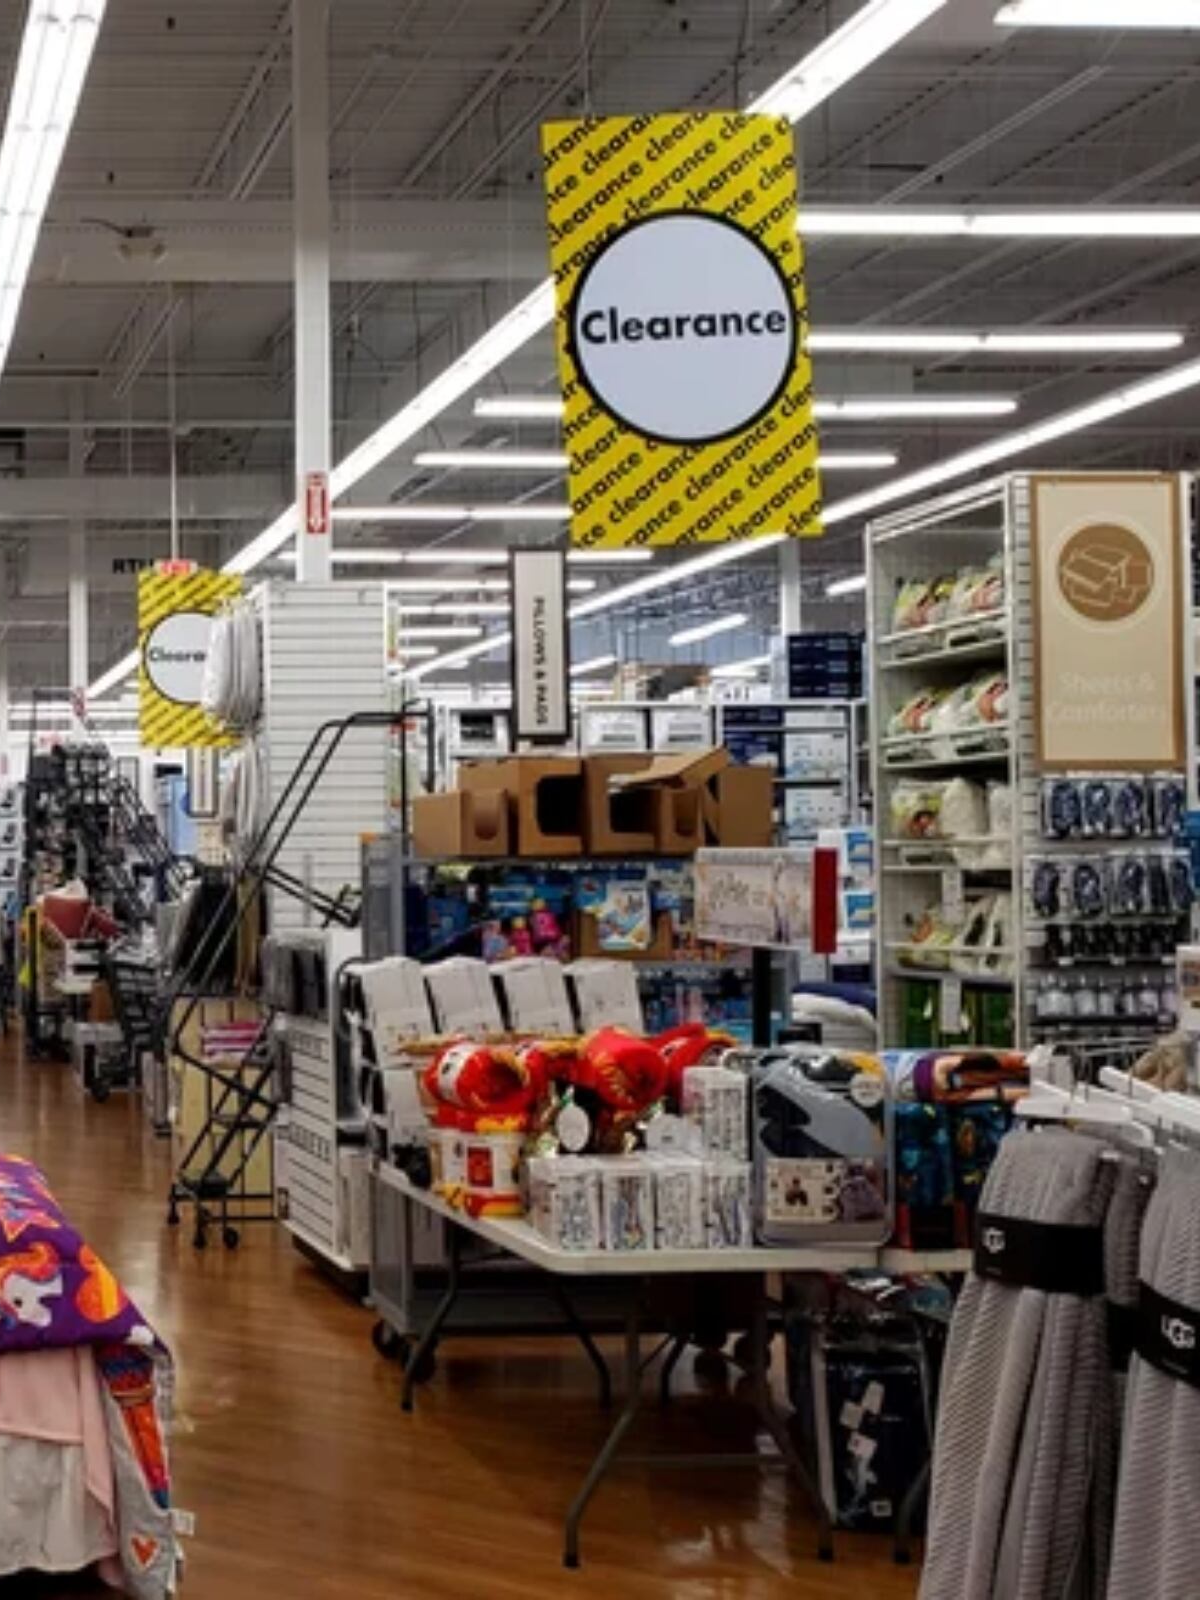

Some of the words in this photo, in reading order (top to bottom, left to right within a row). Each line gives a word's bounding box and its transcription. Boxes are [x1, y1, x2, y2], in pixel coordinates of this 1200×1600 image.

[624, 139, 717, 221] clearance
[580, 306, 787, 345] Clearance
[686, 417, 778, 500] clearance
[726, 467, 815, 541] learance
[533, 597, 546, 666] PILLOWS
[536, 685, 548, 726] PADS
[1161, 1314, 1196, 1349] UGG
